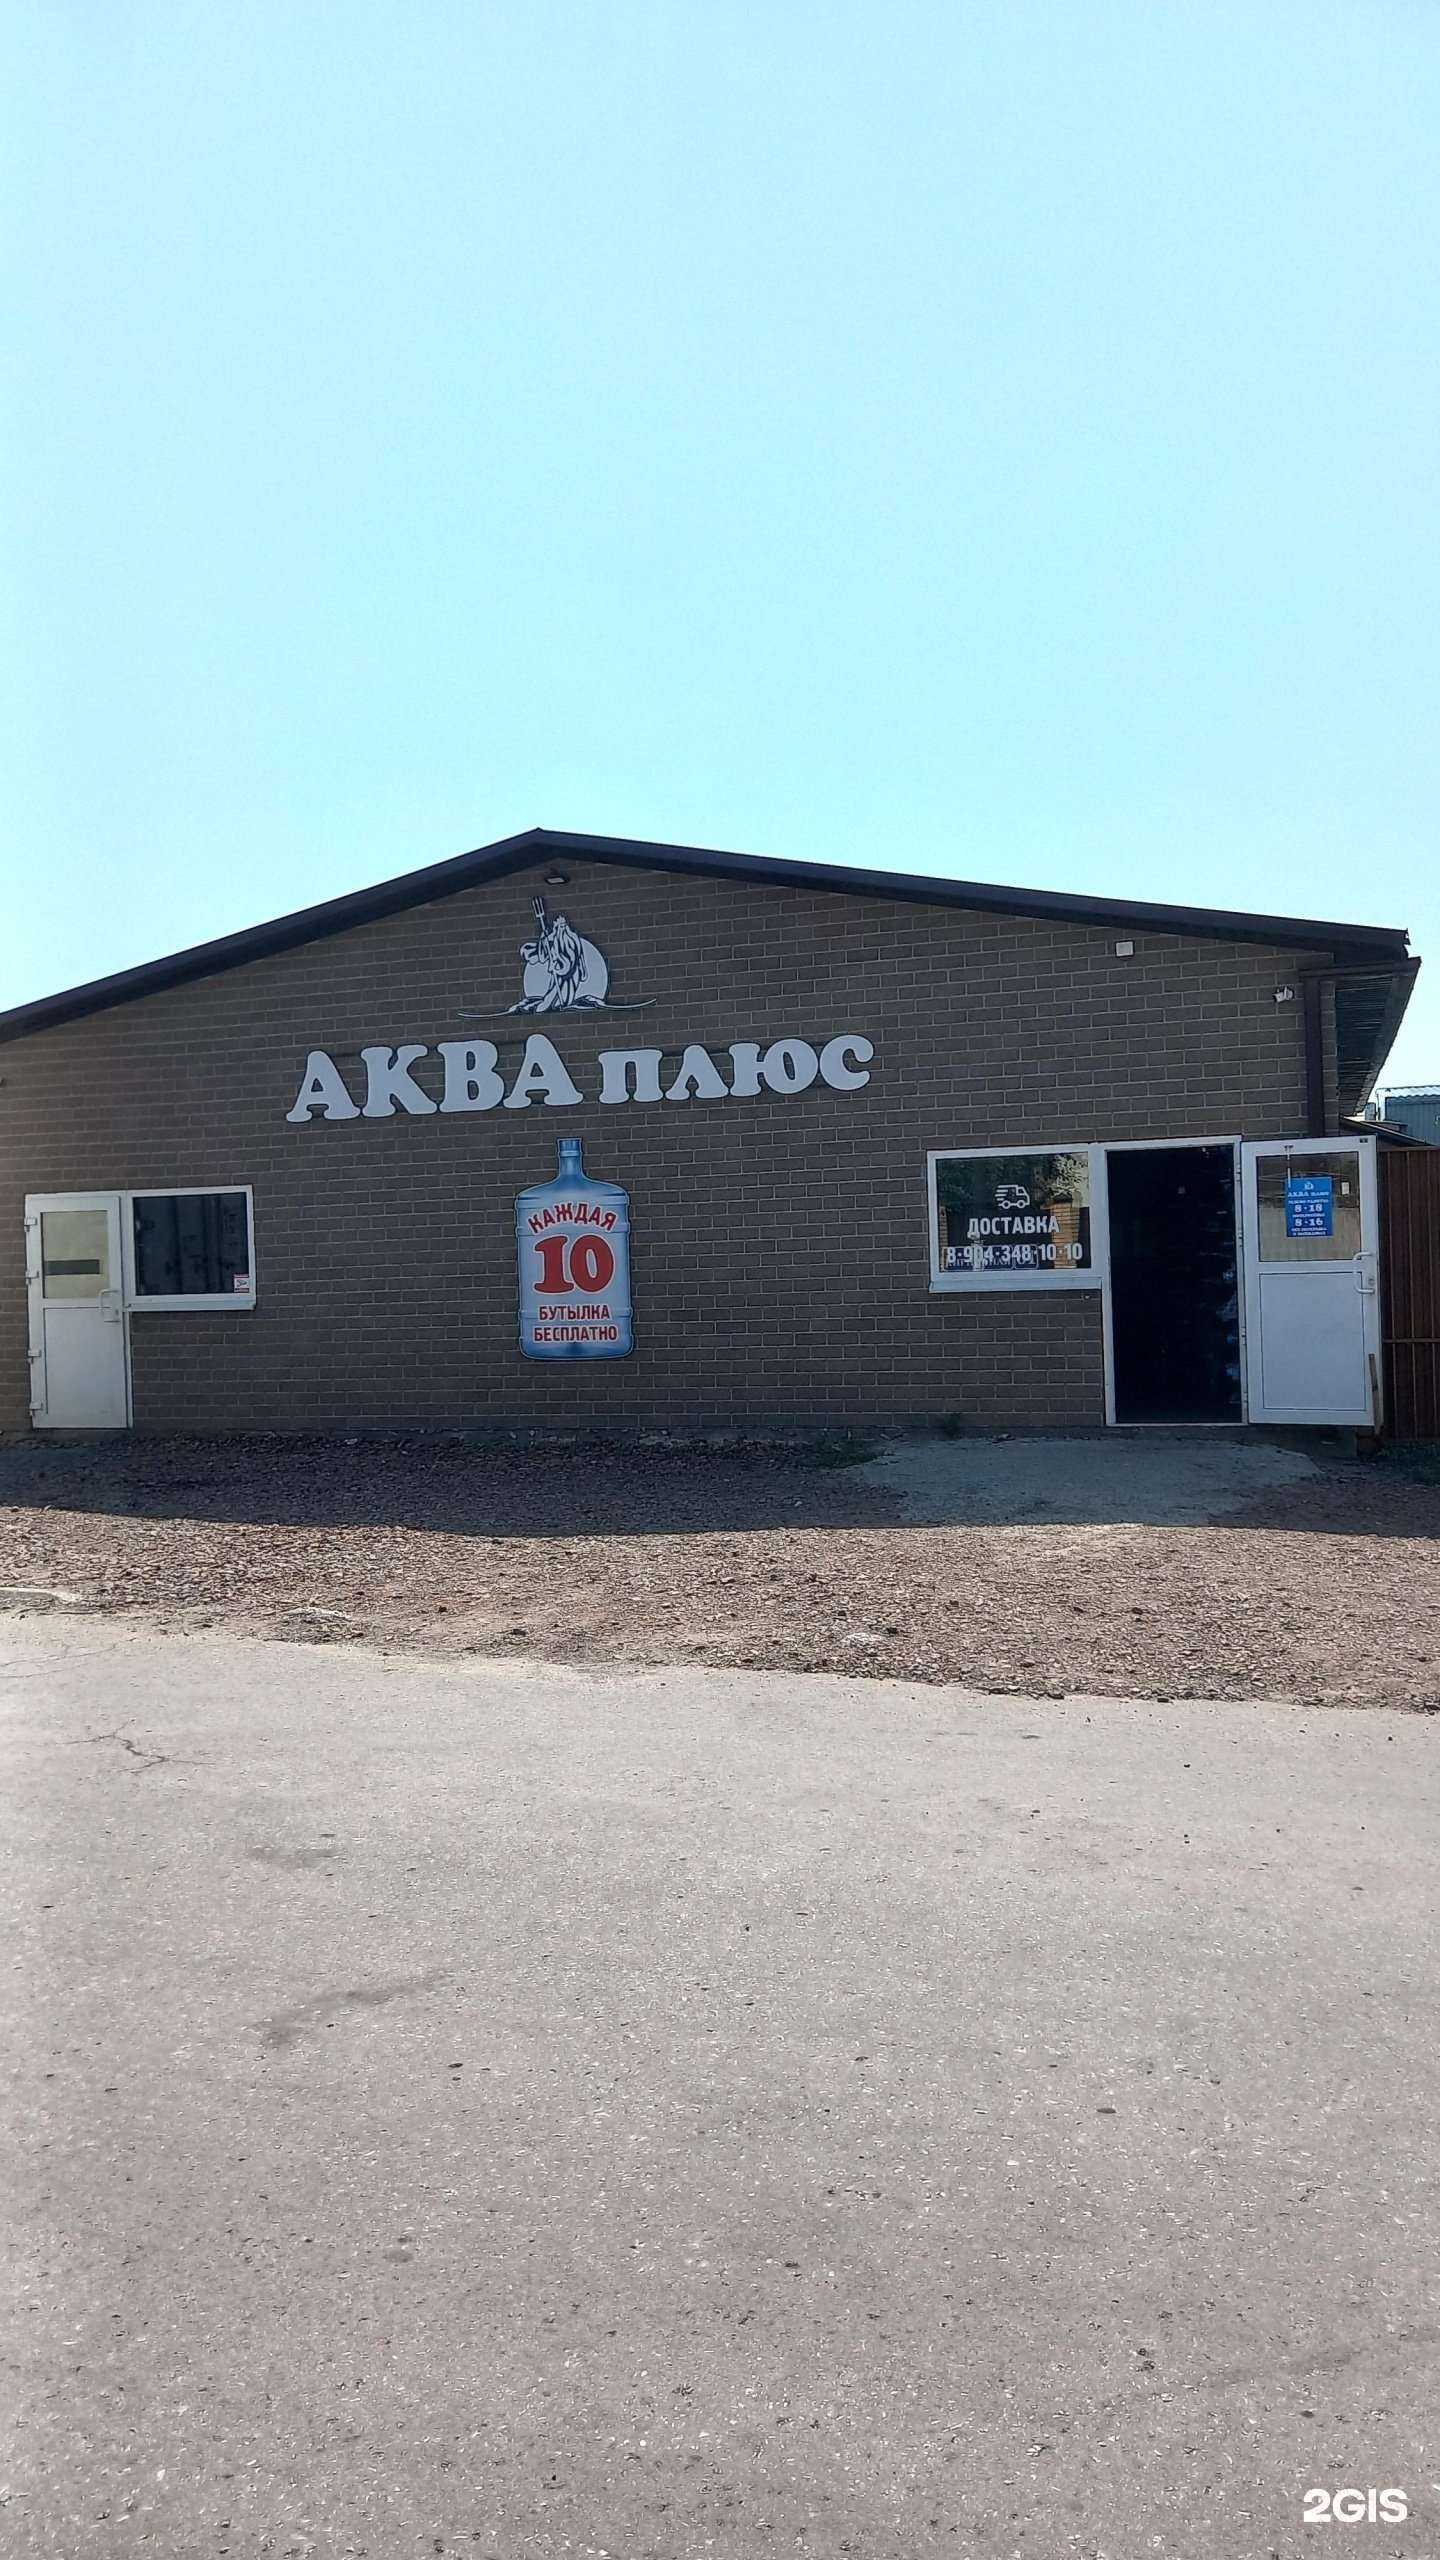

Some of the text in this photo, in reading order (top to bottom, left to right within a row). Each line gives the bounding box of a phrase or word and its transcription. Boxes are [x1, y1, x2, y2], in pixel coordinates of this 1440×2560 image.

[286, 1034, 584, 1123] АКВА
[527, 1203, 618, 1234] КАЖДАЯ
[967, 1216, 1061, 1235] ДОСТАВКА
[533, 1235, 615, 1294] 10
[539, 1305, 610, 1321] БУТЫЛКА
[534, 1325, 618, 1343] БЕСПЛАТНО
